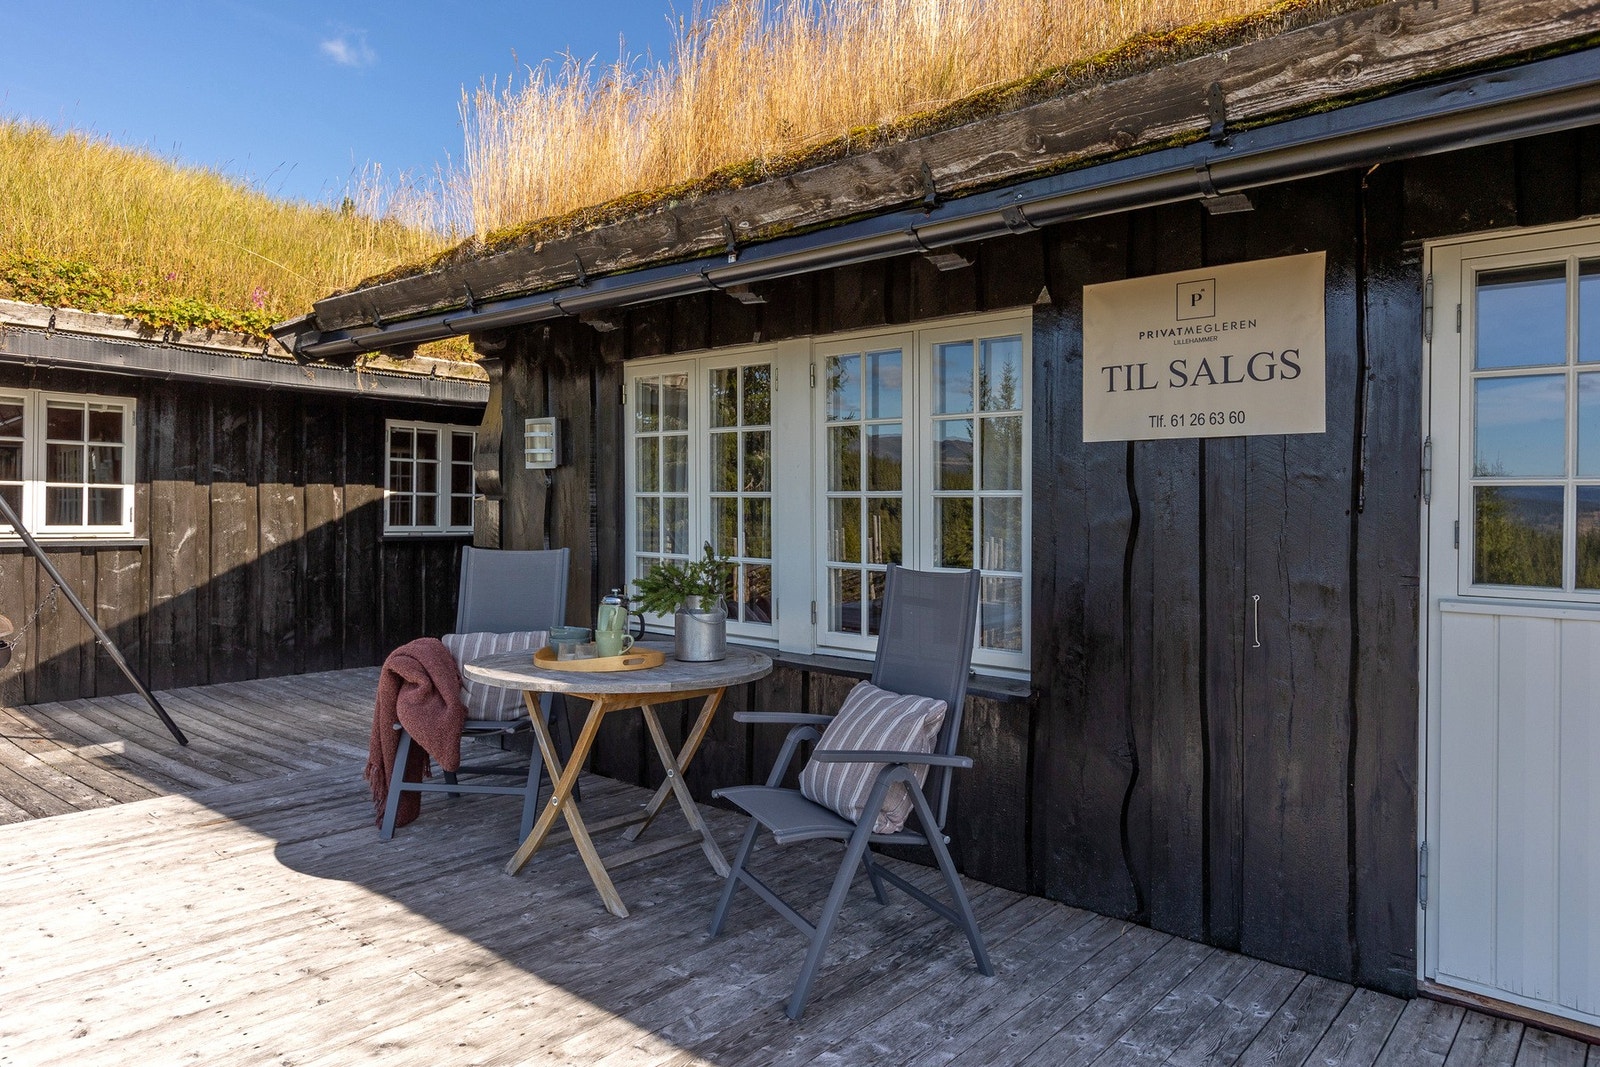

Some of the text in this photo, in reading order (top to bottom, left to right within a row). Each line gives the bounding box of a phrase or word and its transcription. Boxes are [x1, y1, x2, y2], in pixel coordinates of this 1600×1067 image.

[1139, 319, 1257, 340] PRIVATMEGLEREN
[1173, 336, 1218, 345] LILLEHAMMER
[1101, 348, 1302, 393] TIL SALGS
[1149, 410, 1246, 428] Tlf. 61 26 63 60
